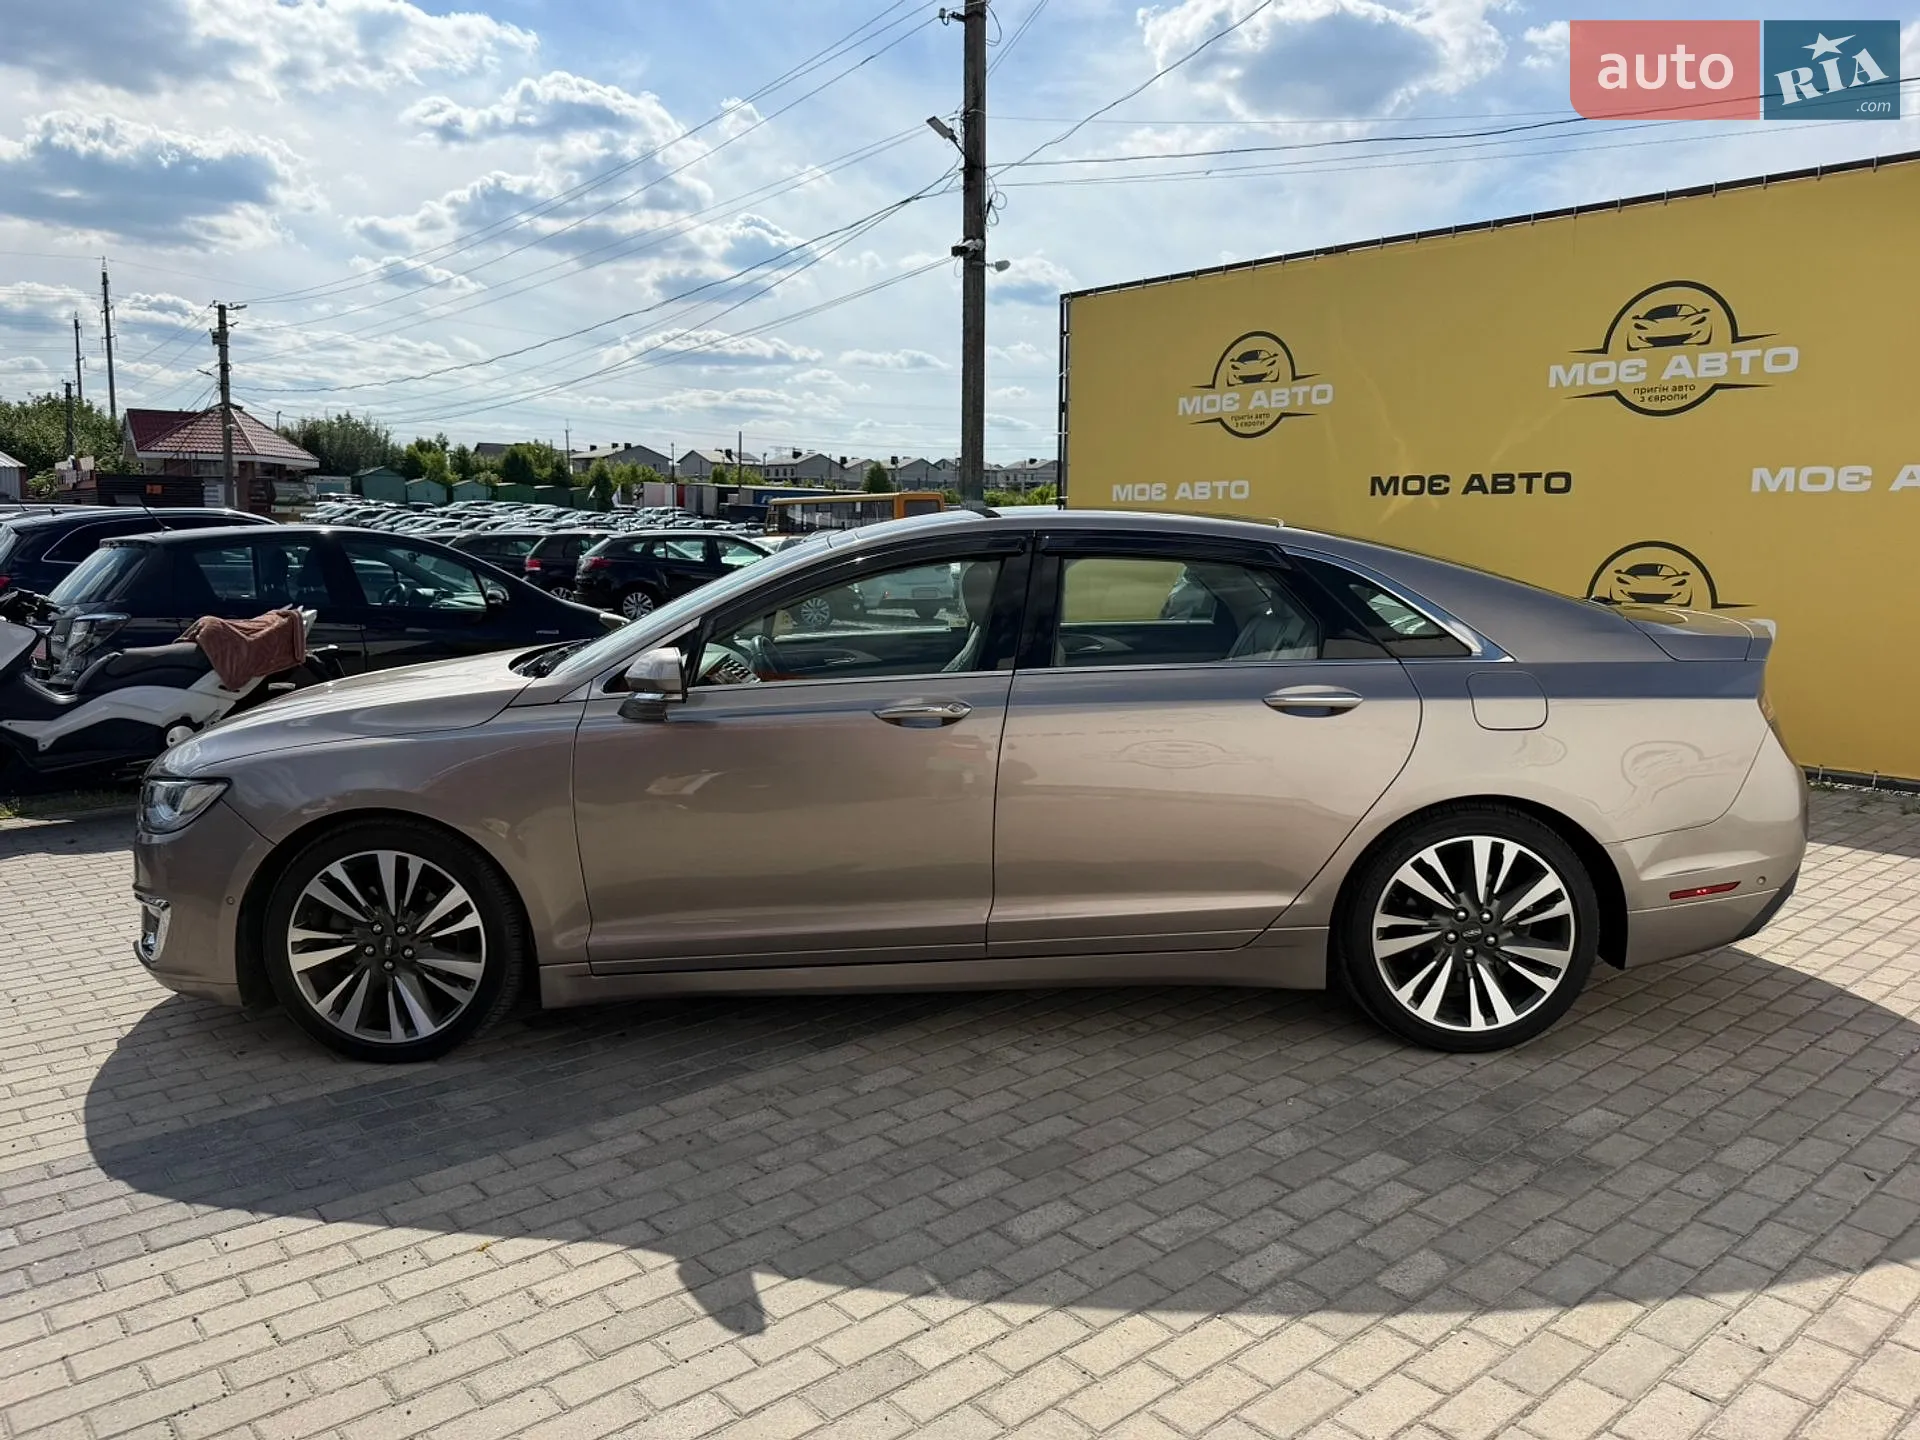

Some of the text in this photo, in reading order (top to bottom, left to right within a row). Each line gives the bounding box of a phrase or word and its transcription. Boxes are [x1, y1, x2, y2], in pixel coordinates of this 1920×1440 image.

[1548, 346, 1800, 388] МОЄ АВТО
[1177, 383, 1334, 416] МОЄ АВТО
[1671, 383, 1696, 393] авто
[1112, 480, 1250, 502] МОЄ АВТО
[1370, 471, 1572, 497] МОЄ АВТО
[1751, 465, 1873, 493] МОЄ
